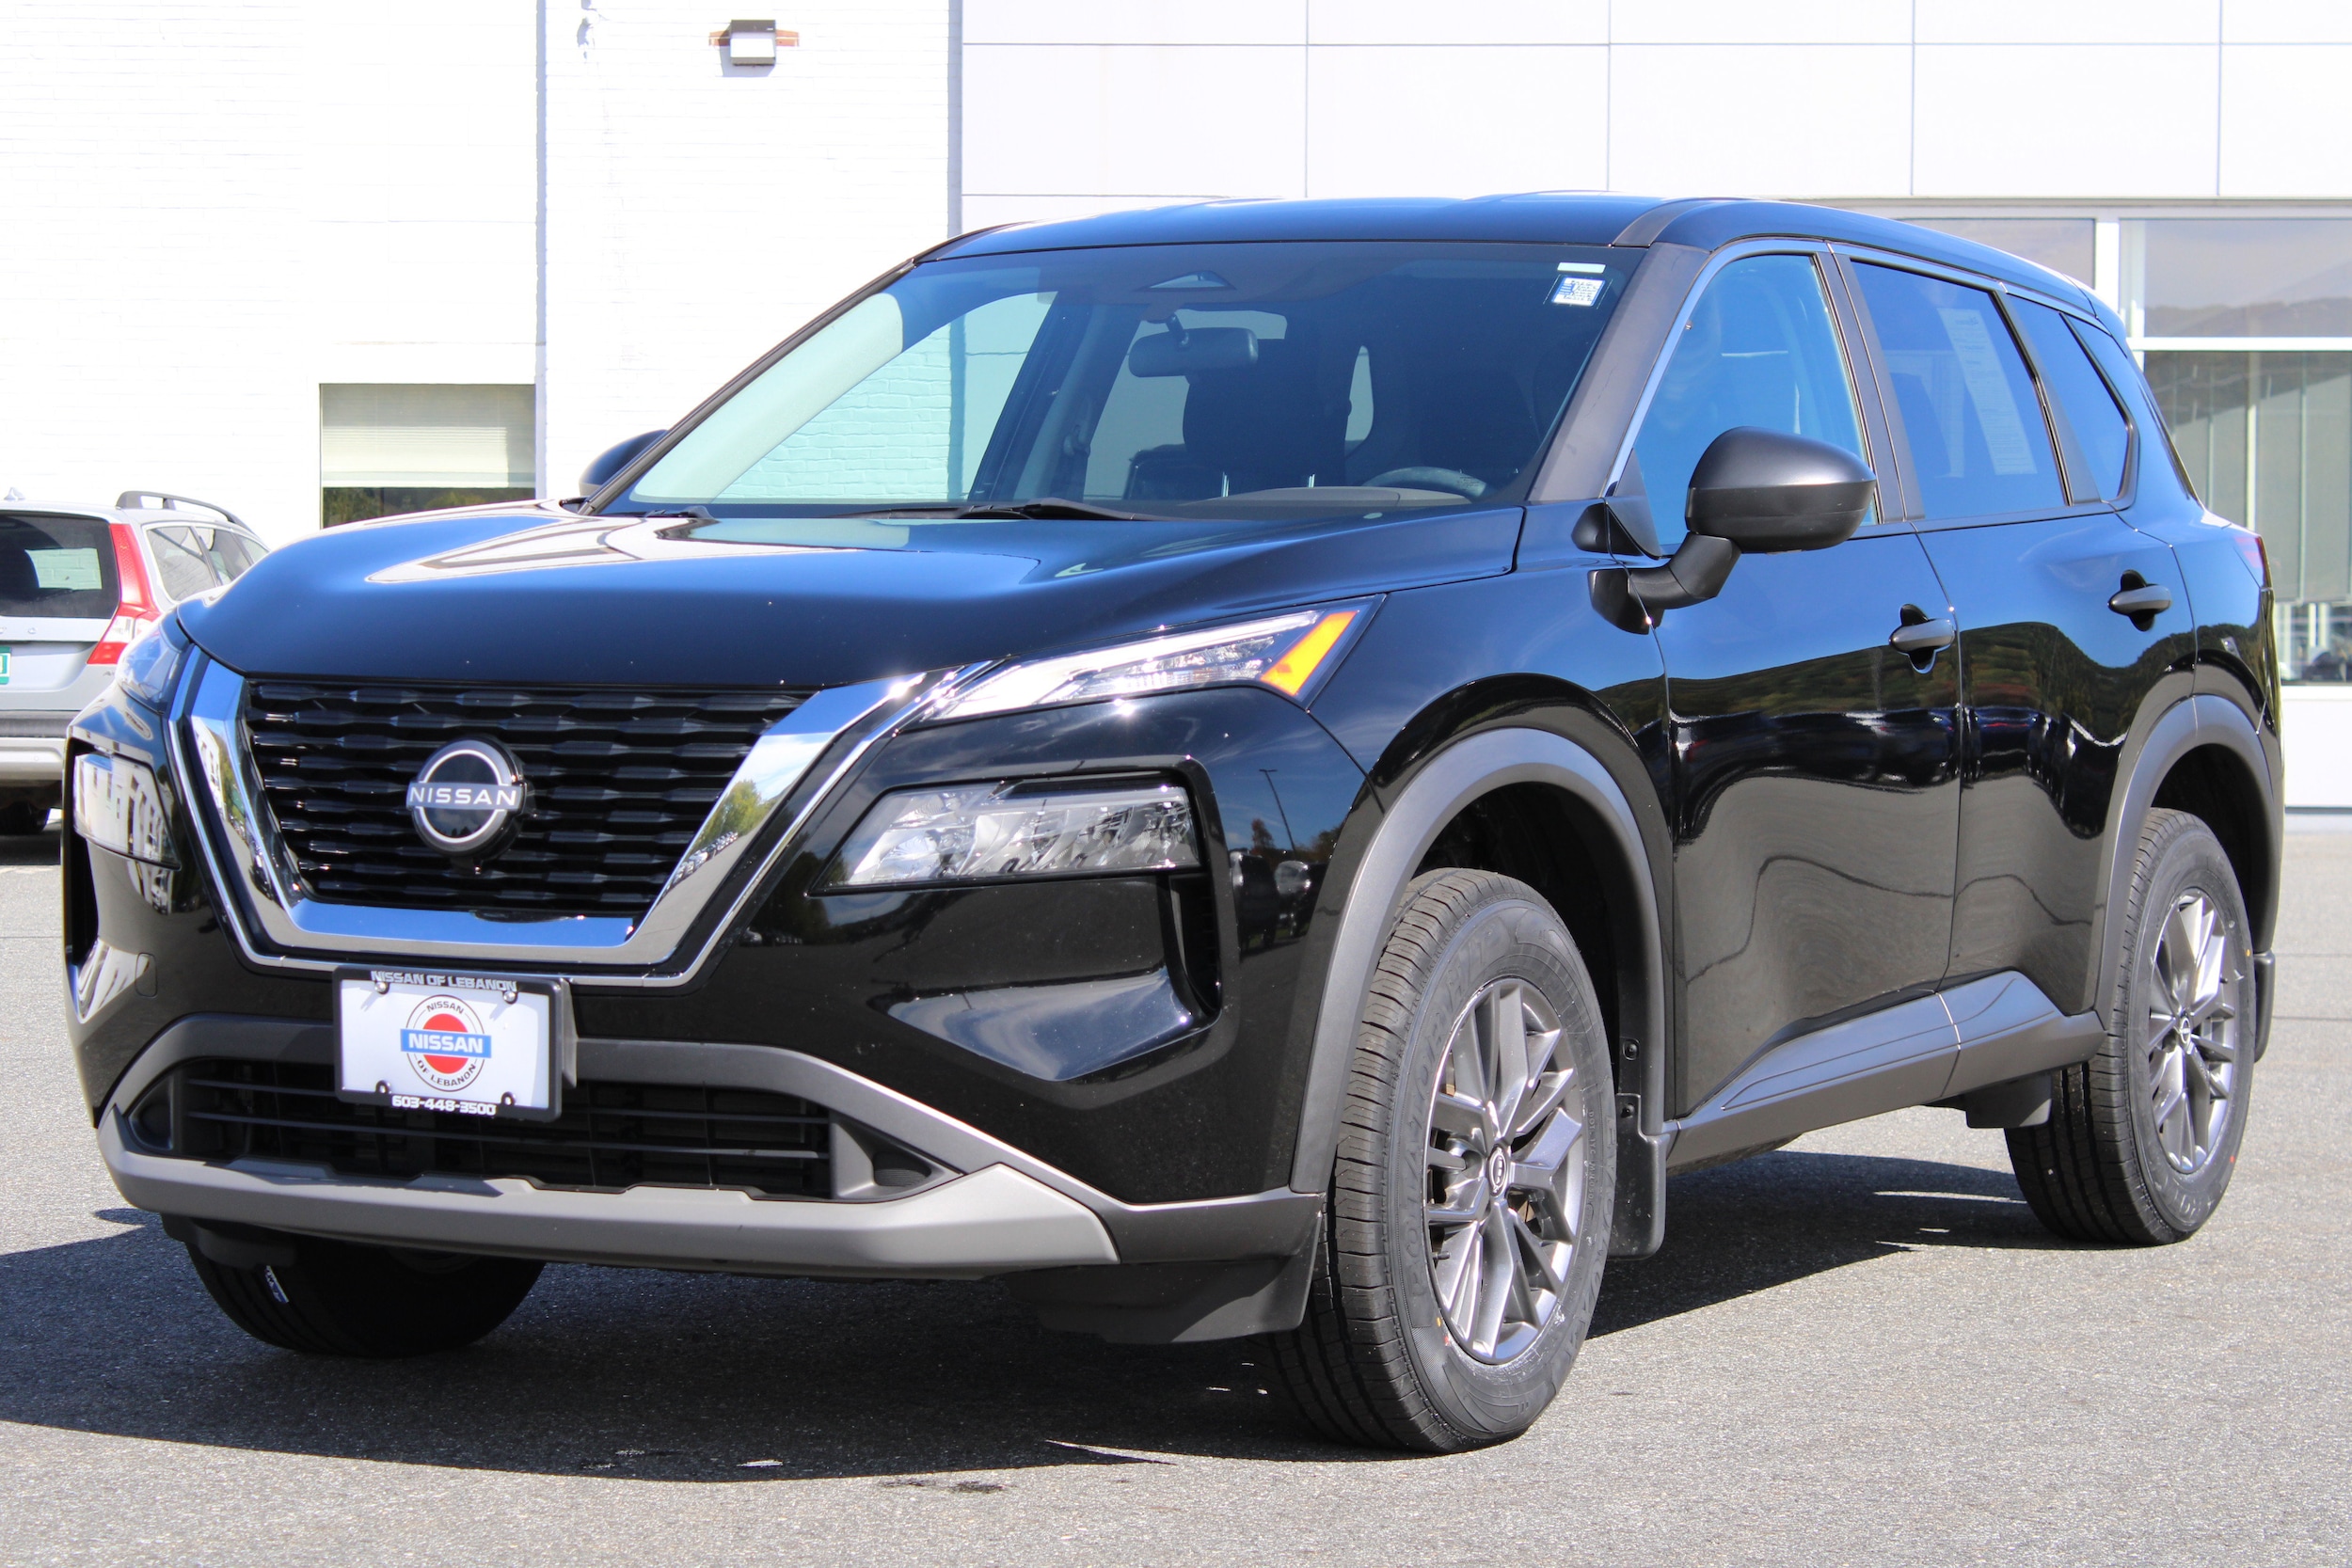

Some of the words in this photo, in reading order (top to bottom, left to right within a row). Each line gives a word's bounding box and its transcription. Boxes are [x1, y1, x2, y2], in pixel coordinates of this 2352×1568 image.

[409, 787, 516, 805] NISSAN
[371, 971, 425, 985] NISSAN
[426, 975, 446, 986] OF
[448, 976, 517, 991] LEBANON
[426, 1001, 464, 1014] NISSAN
[408, 1033, 483, 1053] NISSAN
[417, 1060, 430, 1073] OF
[430, 1063, 476, 1086] LEBANON
[391, 1095, 497, 1116] 603-448-3500
